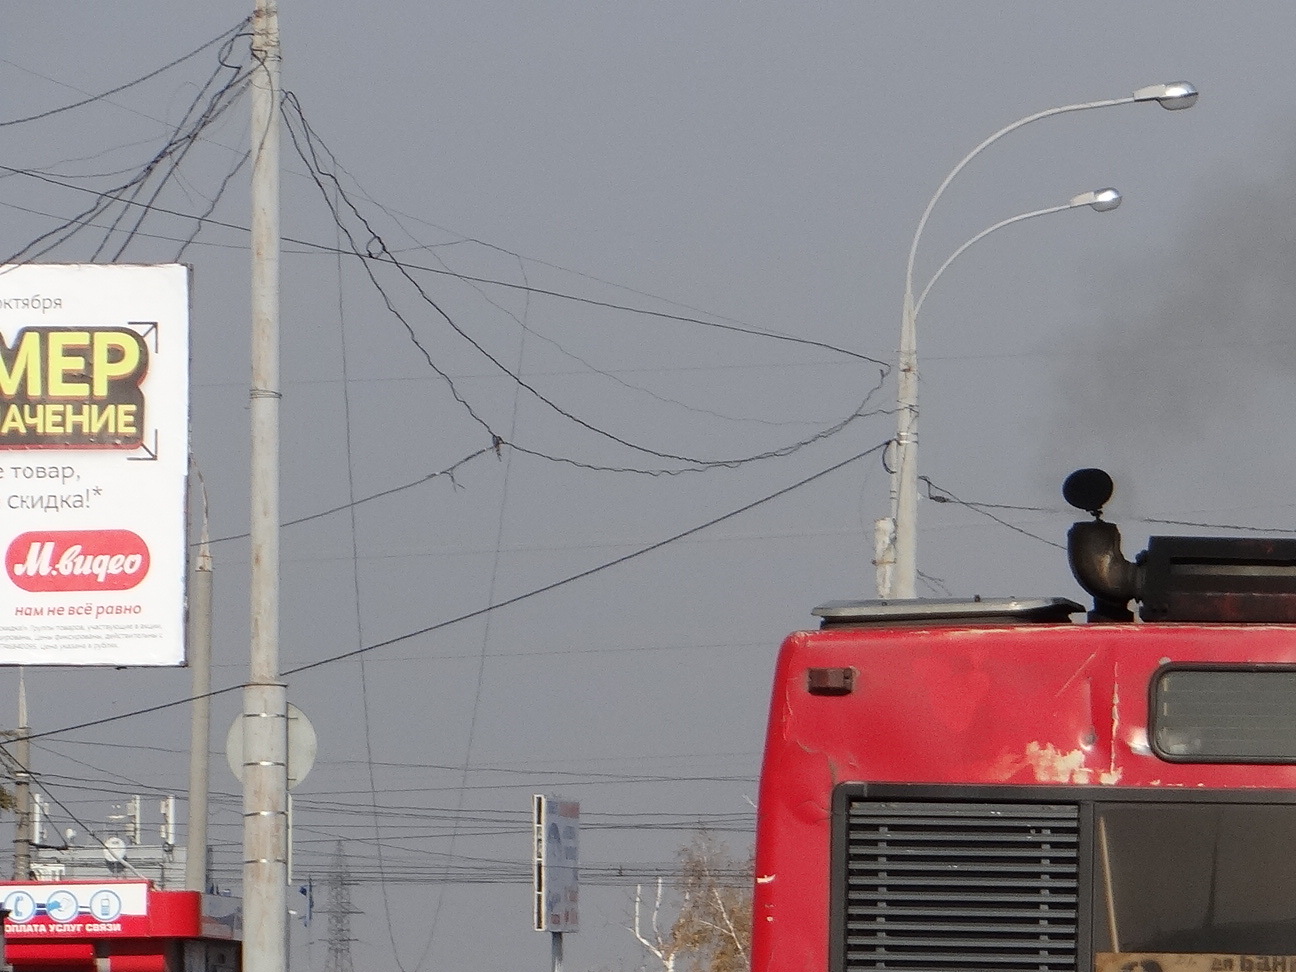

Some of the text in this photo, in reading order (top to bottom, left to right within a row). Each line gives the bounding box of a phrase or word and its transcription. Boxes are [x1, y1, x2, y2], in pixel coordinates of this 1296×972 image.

[0, 294, 62, 314] ктября
[0, 404, 137, 433] АЧЕНИЕ
[11, 466, 80, 484] товар,
[13, 542, 143, 583] М.видео
[15, 603, 142, 619] нам не всё равно
[4, 923, 121, 933] ОПЛАТА УСЛУГ СВЯЗИ
